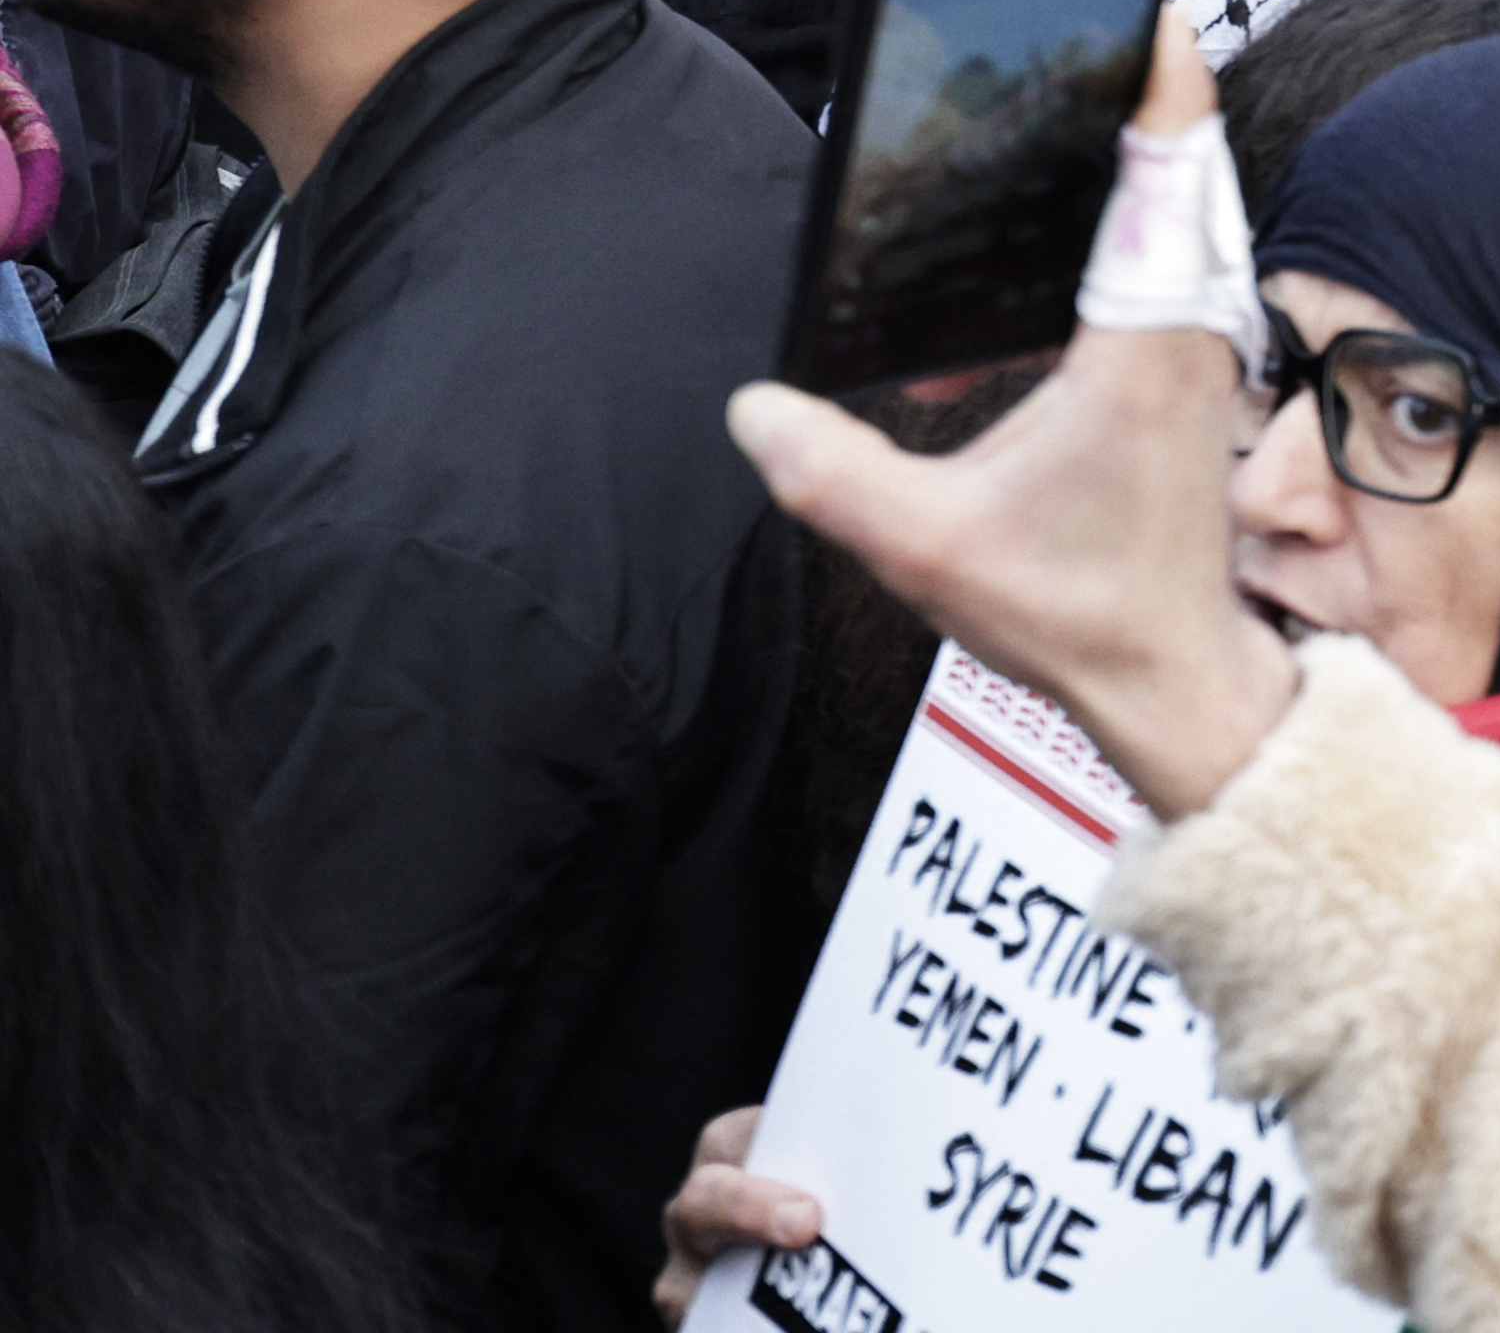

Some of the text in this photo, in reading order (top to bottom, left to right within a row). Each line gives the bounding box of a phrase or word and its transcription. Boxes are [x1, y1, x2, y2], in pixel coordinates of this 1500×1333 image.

[886, 798, 1177, 1039] PALESTINE
[870, 928, 1307, 1273] YEMEN LIBAN
[926, 1133, 1097, 1293] SYRIE
